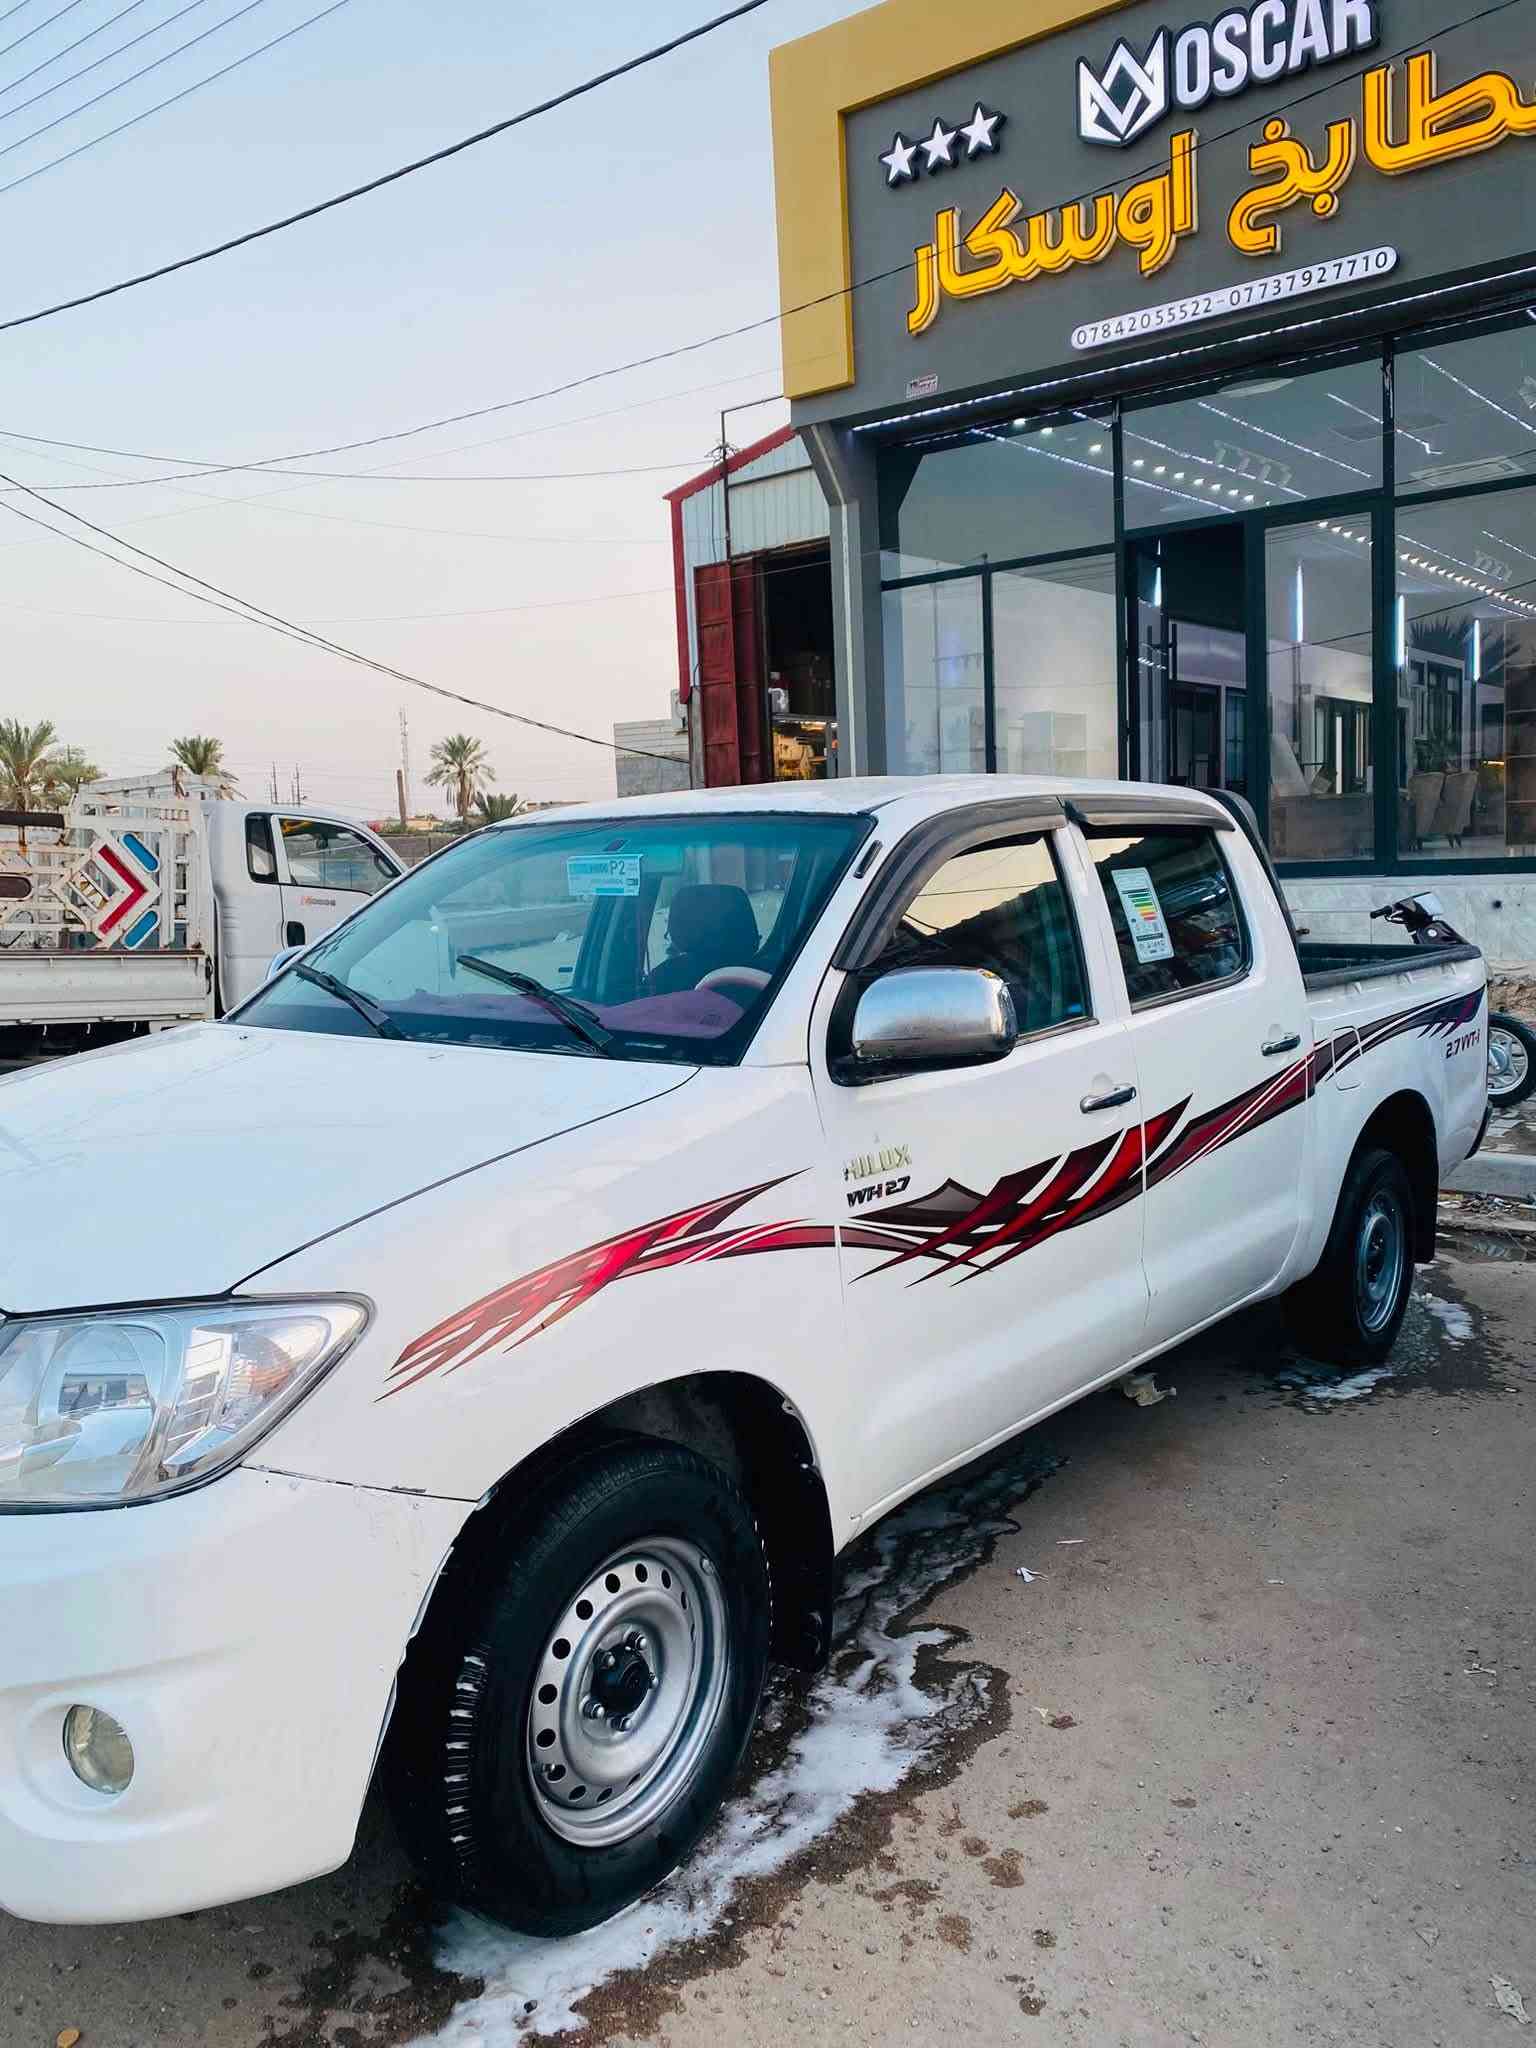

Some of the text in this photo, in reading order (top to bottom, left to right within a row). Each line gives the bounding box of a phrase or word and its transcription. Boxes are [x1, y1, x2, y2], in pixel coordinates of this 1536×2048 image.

[1175, 0, 1374, 105] OSCAR
[906, 49, 1536, 336] طابخ اوسكار
[1076, 251, 1388, 346] 07842055522-07737927710
[843, 1144, 911, 1182] HILUX
